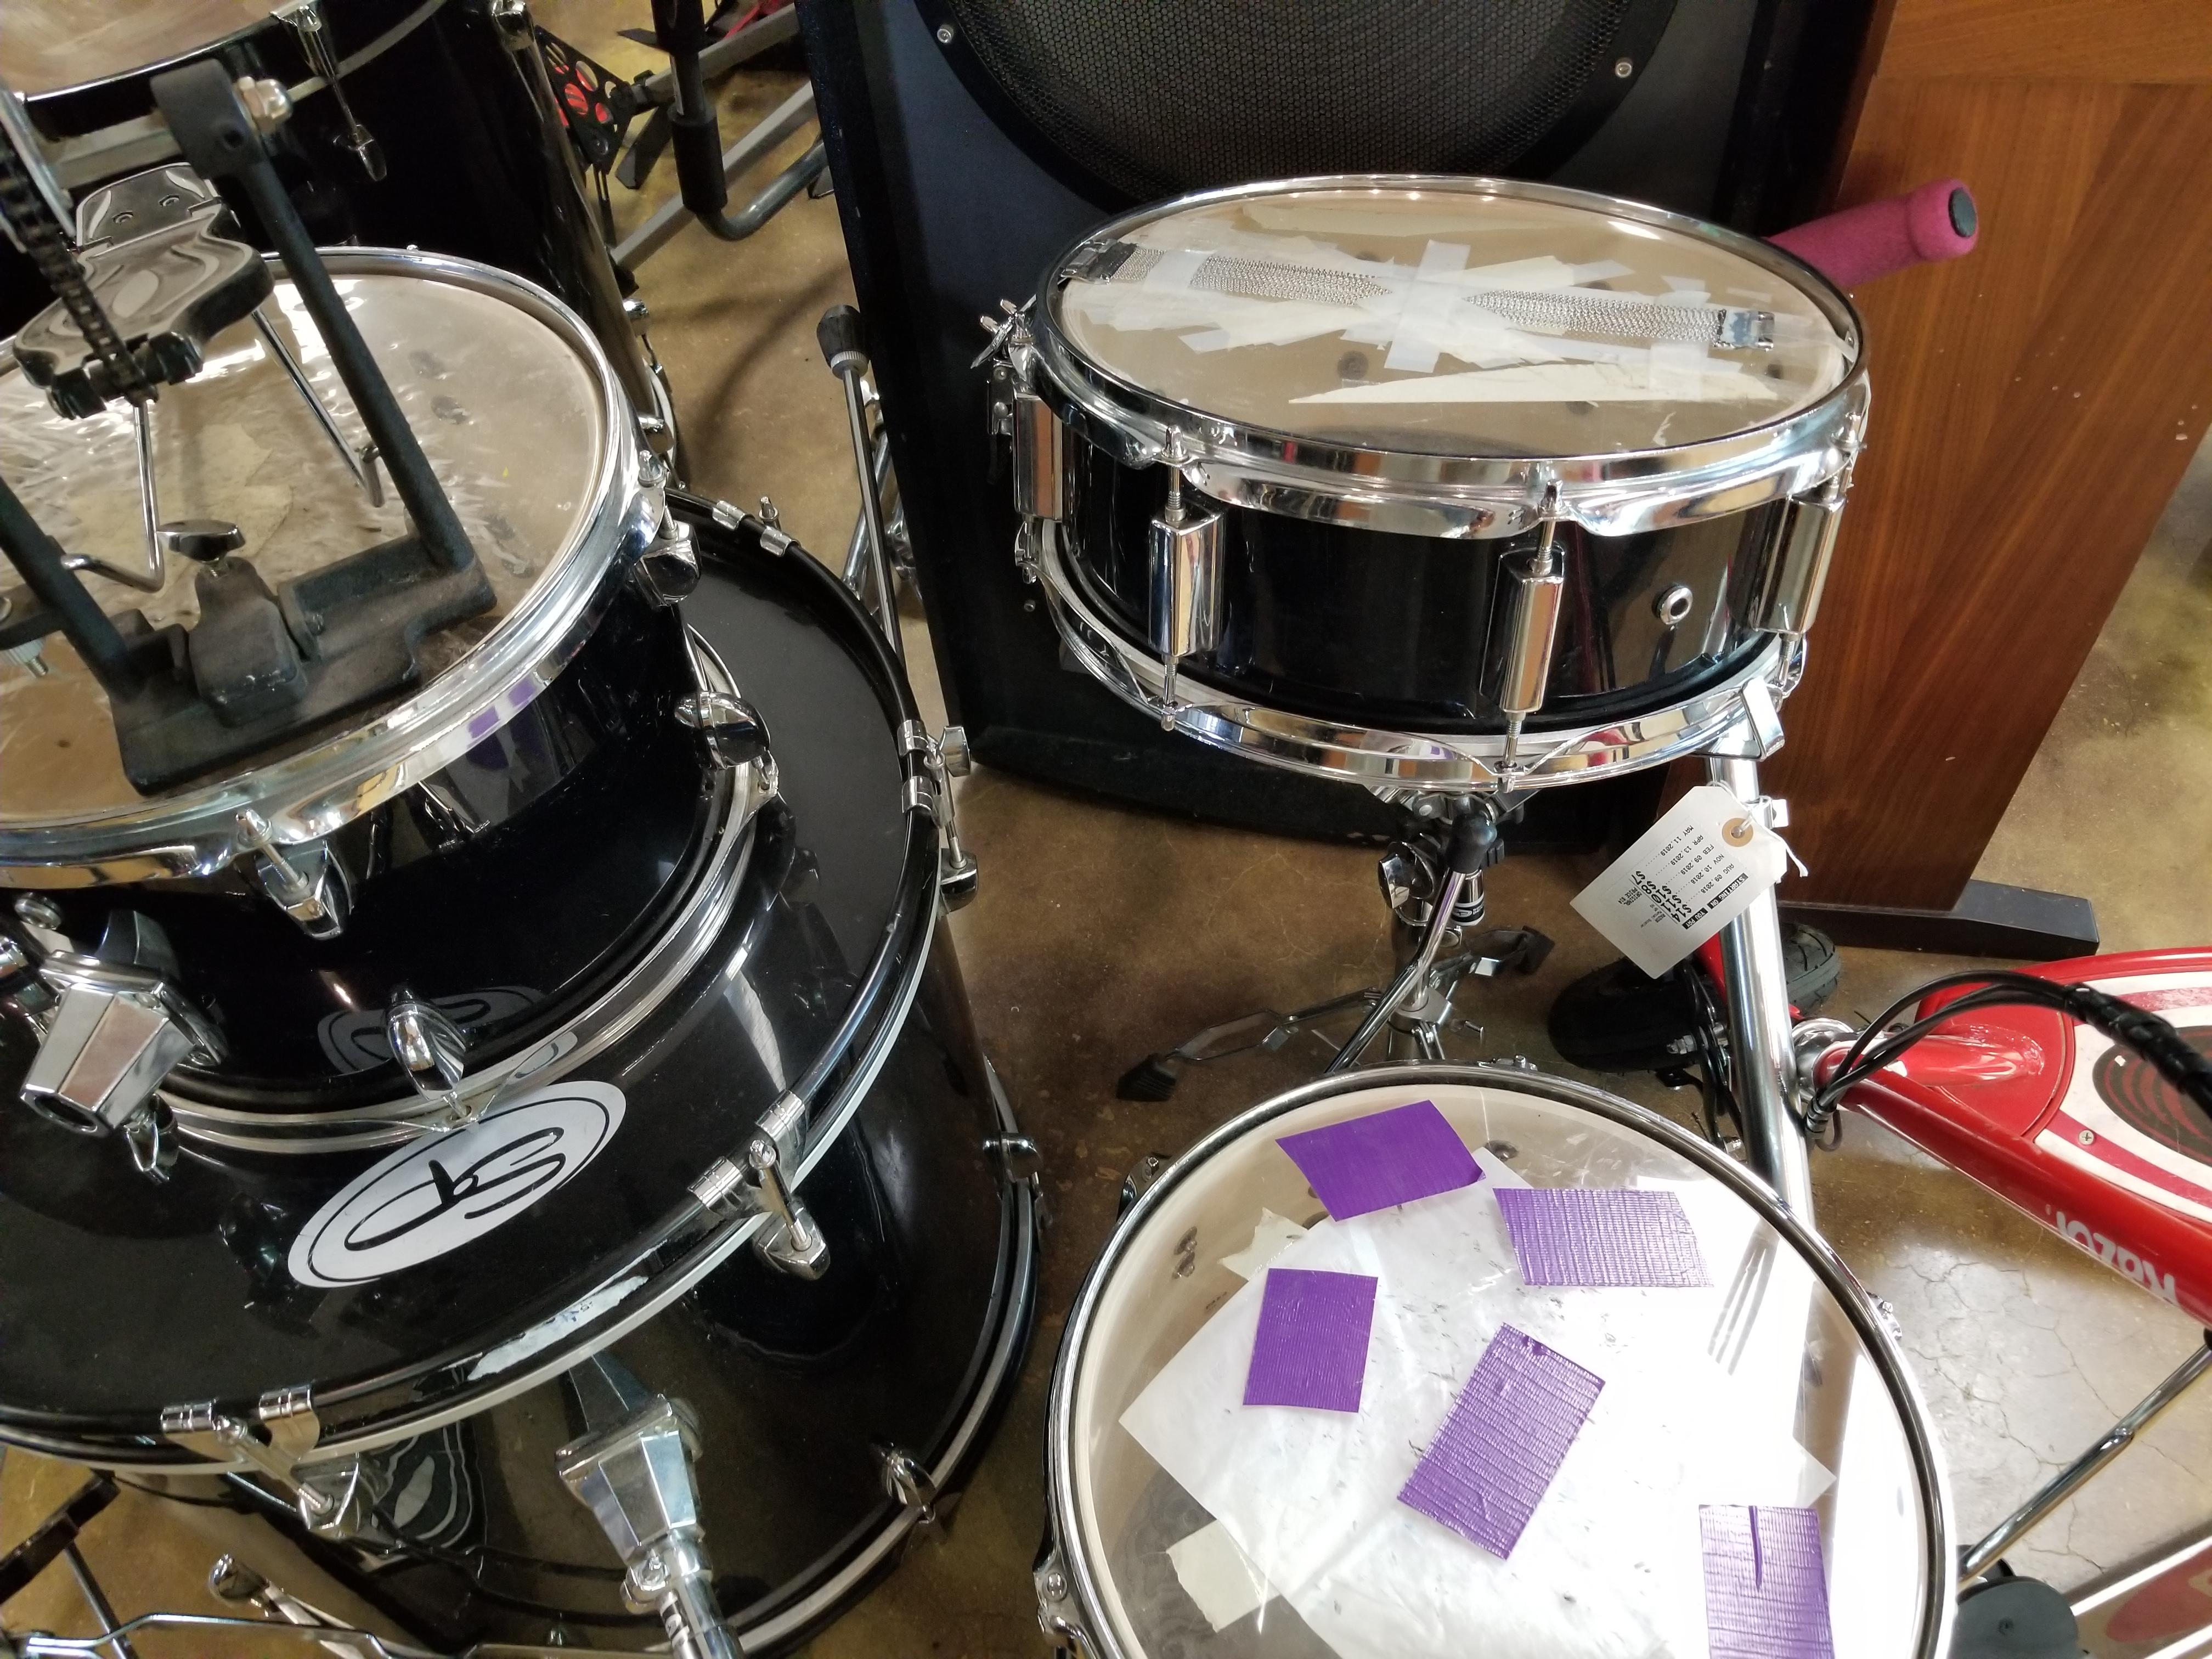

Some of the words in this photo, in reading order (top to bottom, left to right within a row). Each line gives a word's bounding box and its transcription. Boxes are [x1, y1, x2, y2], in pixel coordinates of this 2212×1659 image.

[1681, 825, 1694, 837] MAY
[1691, 834, 1705, 846] APR
[1701, 843, 1714, 855] FEB
[1712, 853, 1725, 865] NOV
[1722, 862, 1735, 874] AUG
[1629, 868, 1647, 885] $7
[1640, 879, 1658, 895] $8
[1717, 876, 1746, 900] STARTING
[1649, 883, 1673, 905] $10
[1660, 893, 1684, 914] $11
[1709, 898, 1719, 907] ON
[1669, 902, 1694, 923] $14
[1694, 910, 1706, 920] YOU
[1684, 917, 1696, 928] PAY
